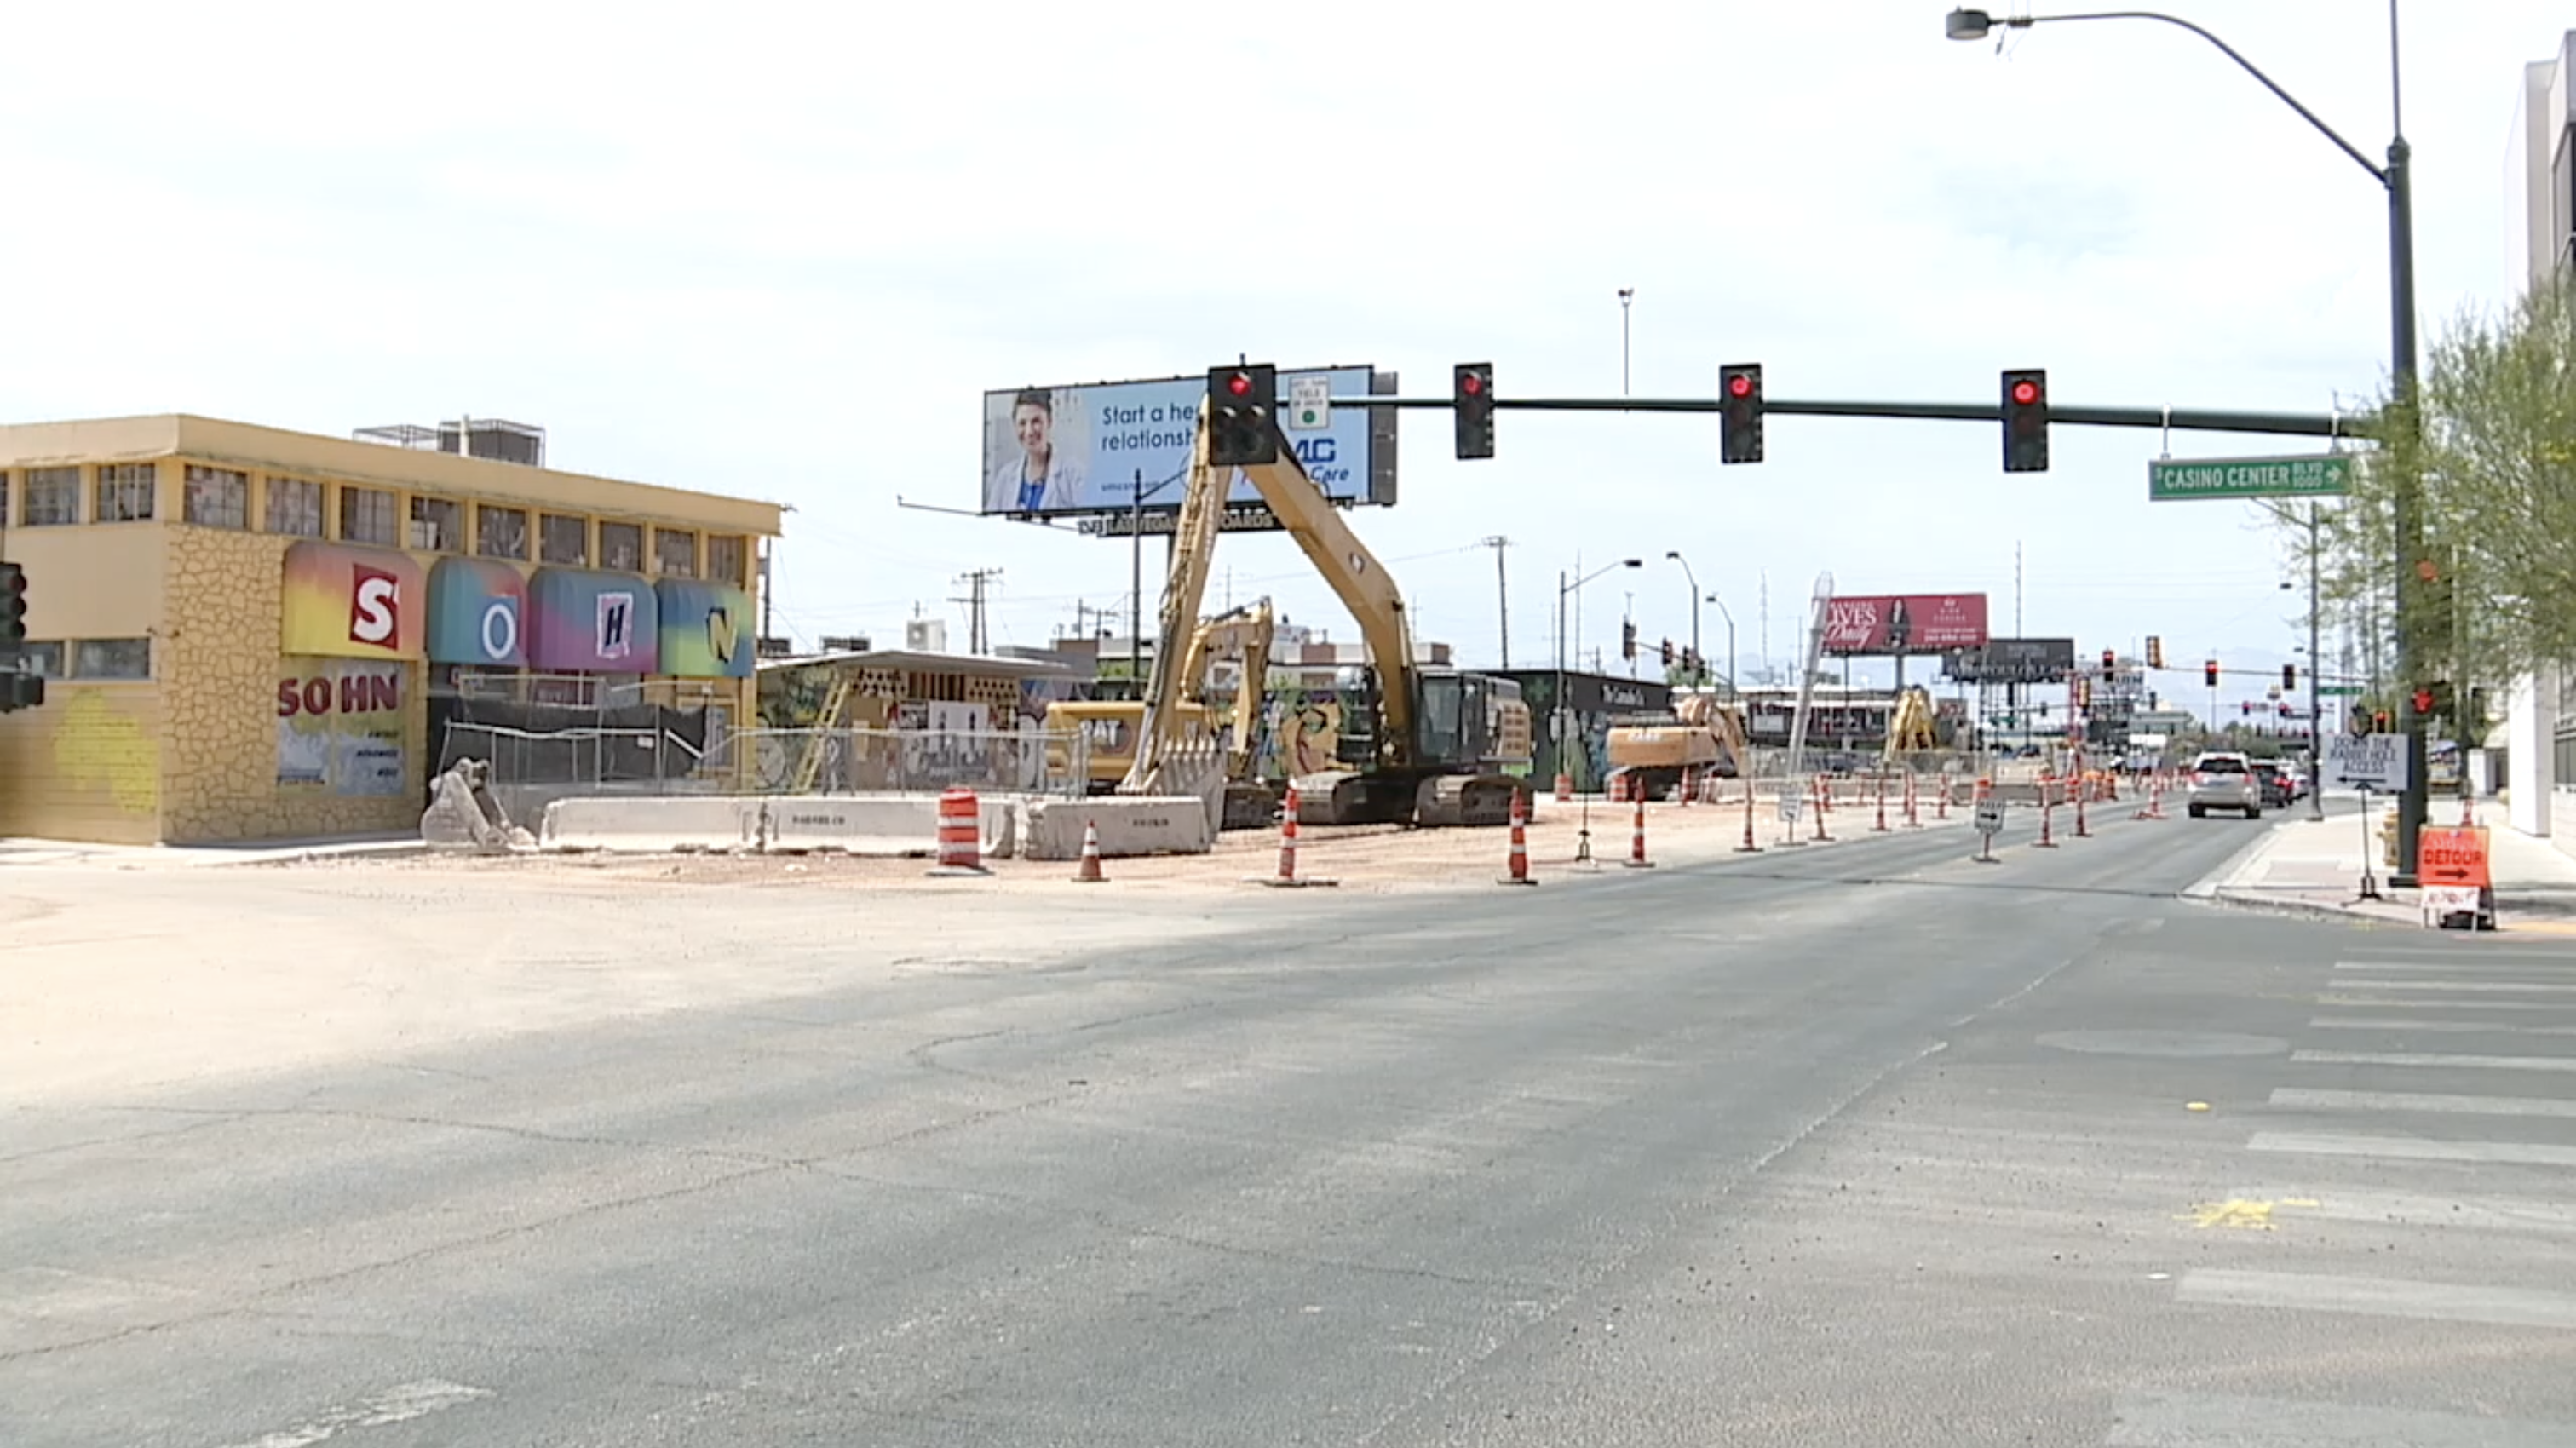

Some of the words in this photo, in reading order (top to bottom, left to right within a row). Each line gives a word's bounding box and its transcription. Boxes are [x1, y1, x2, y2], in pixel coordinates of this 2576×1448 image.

[1102, 404, 1144, 426] Start
[1150, 408, 1164, 422] a
[1169, 402, 1197, 422] he
[2165, 467, 2223, 490] CASINO
[2227, 464, 2291, 488] CENTER
[2292, 462, 2324, 474] BLVD
[2424, 848, 2482, 865] DETOUR
